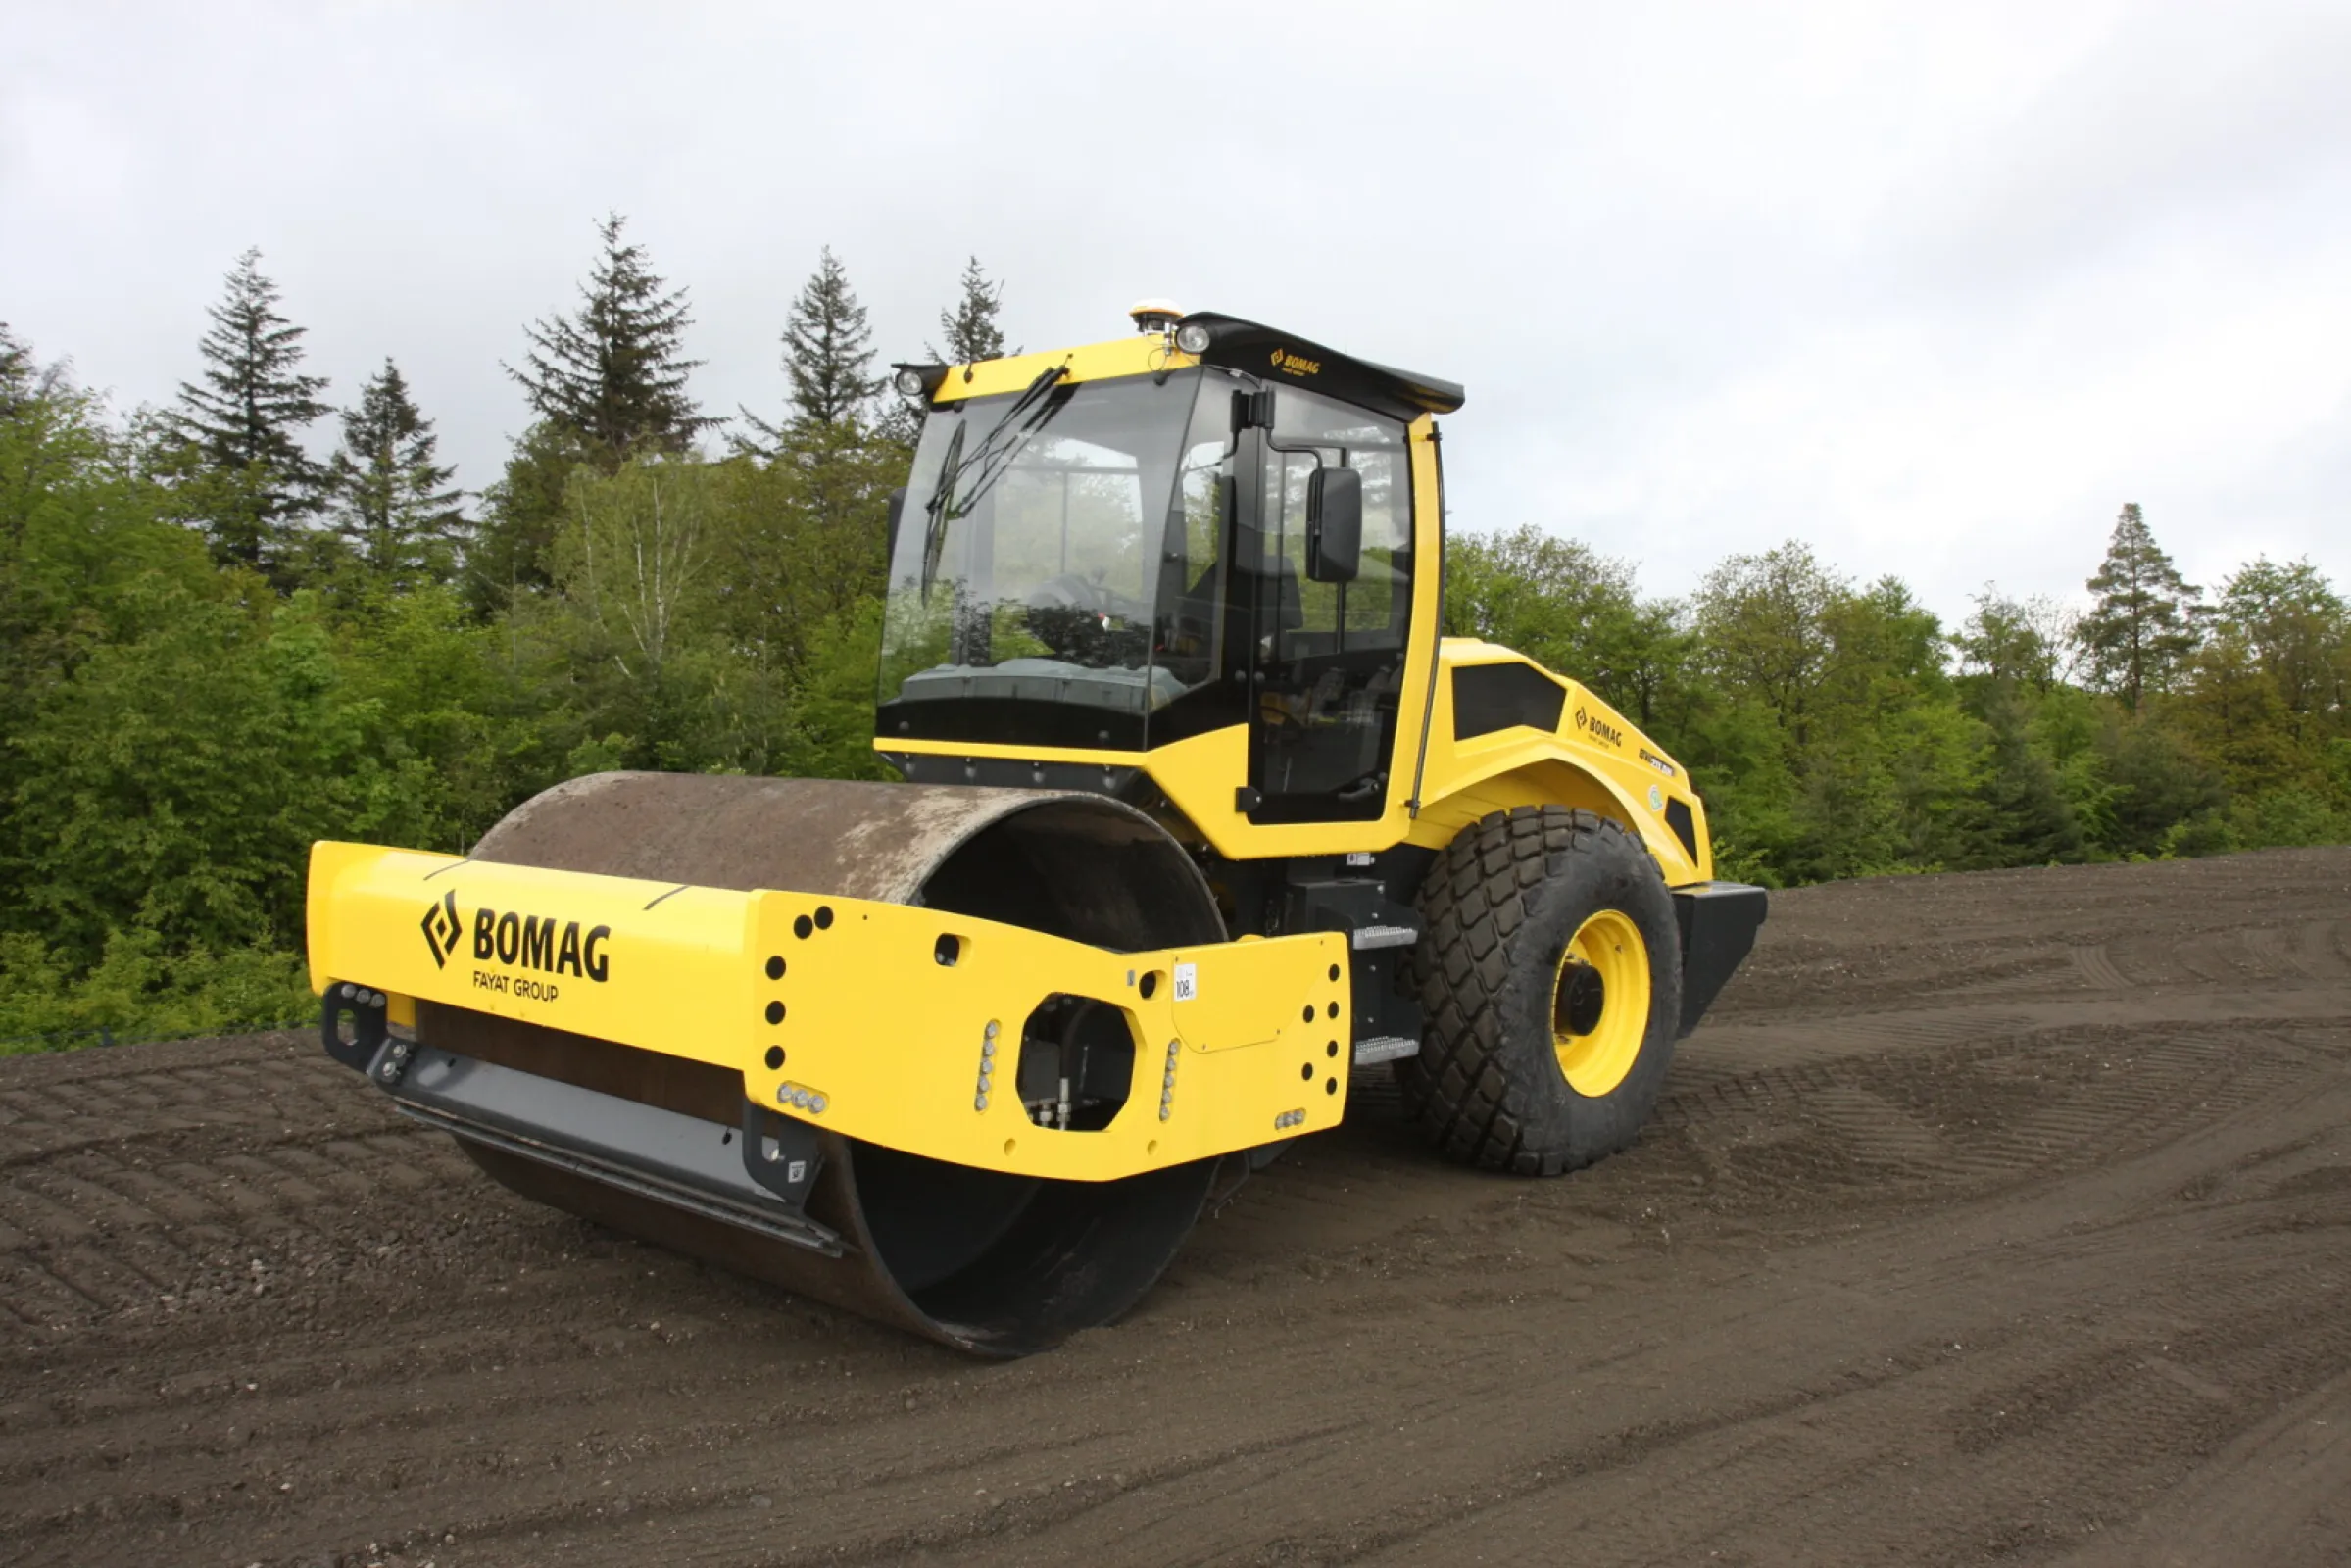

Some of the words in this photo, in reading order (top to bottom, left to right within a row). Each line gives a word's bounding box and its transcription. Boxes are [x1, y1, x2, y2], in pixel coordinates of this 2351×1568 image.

[1285, 354, 1321, 374] BOMAG
[1590, 716, 1622, 748] BOMAG
[473, 907, 612, 983] BOMAG
[472, 970, 510, 994] FAYAT
[514, 978, 559, 1003] GROUP
[1176, 979, 1190, 999] 108
